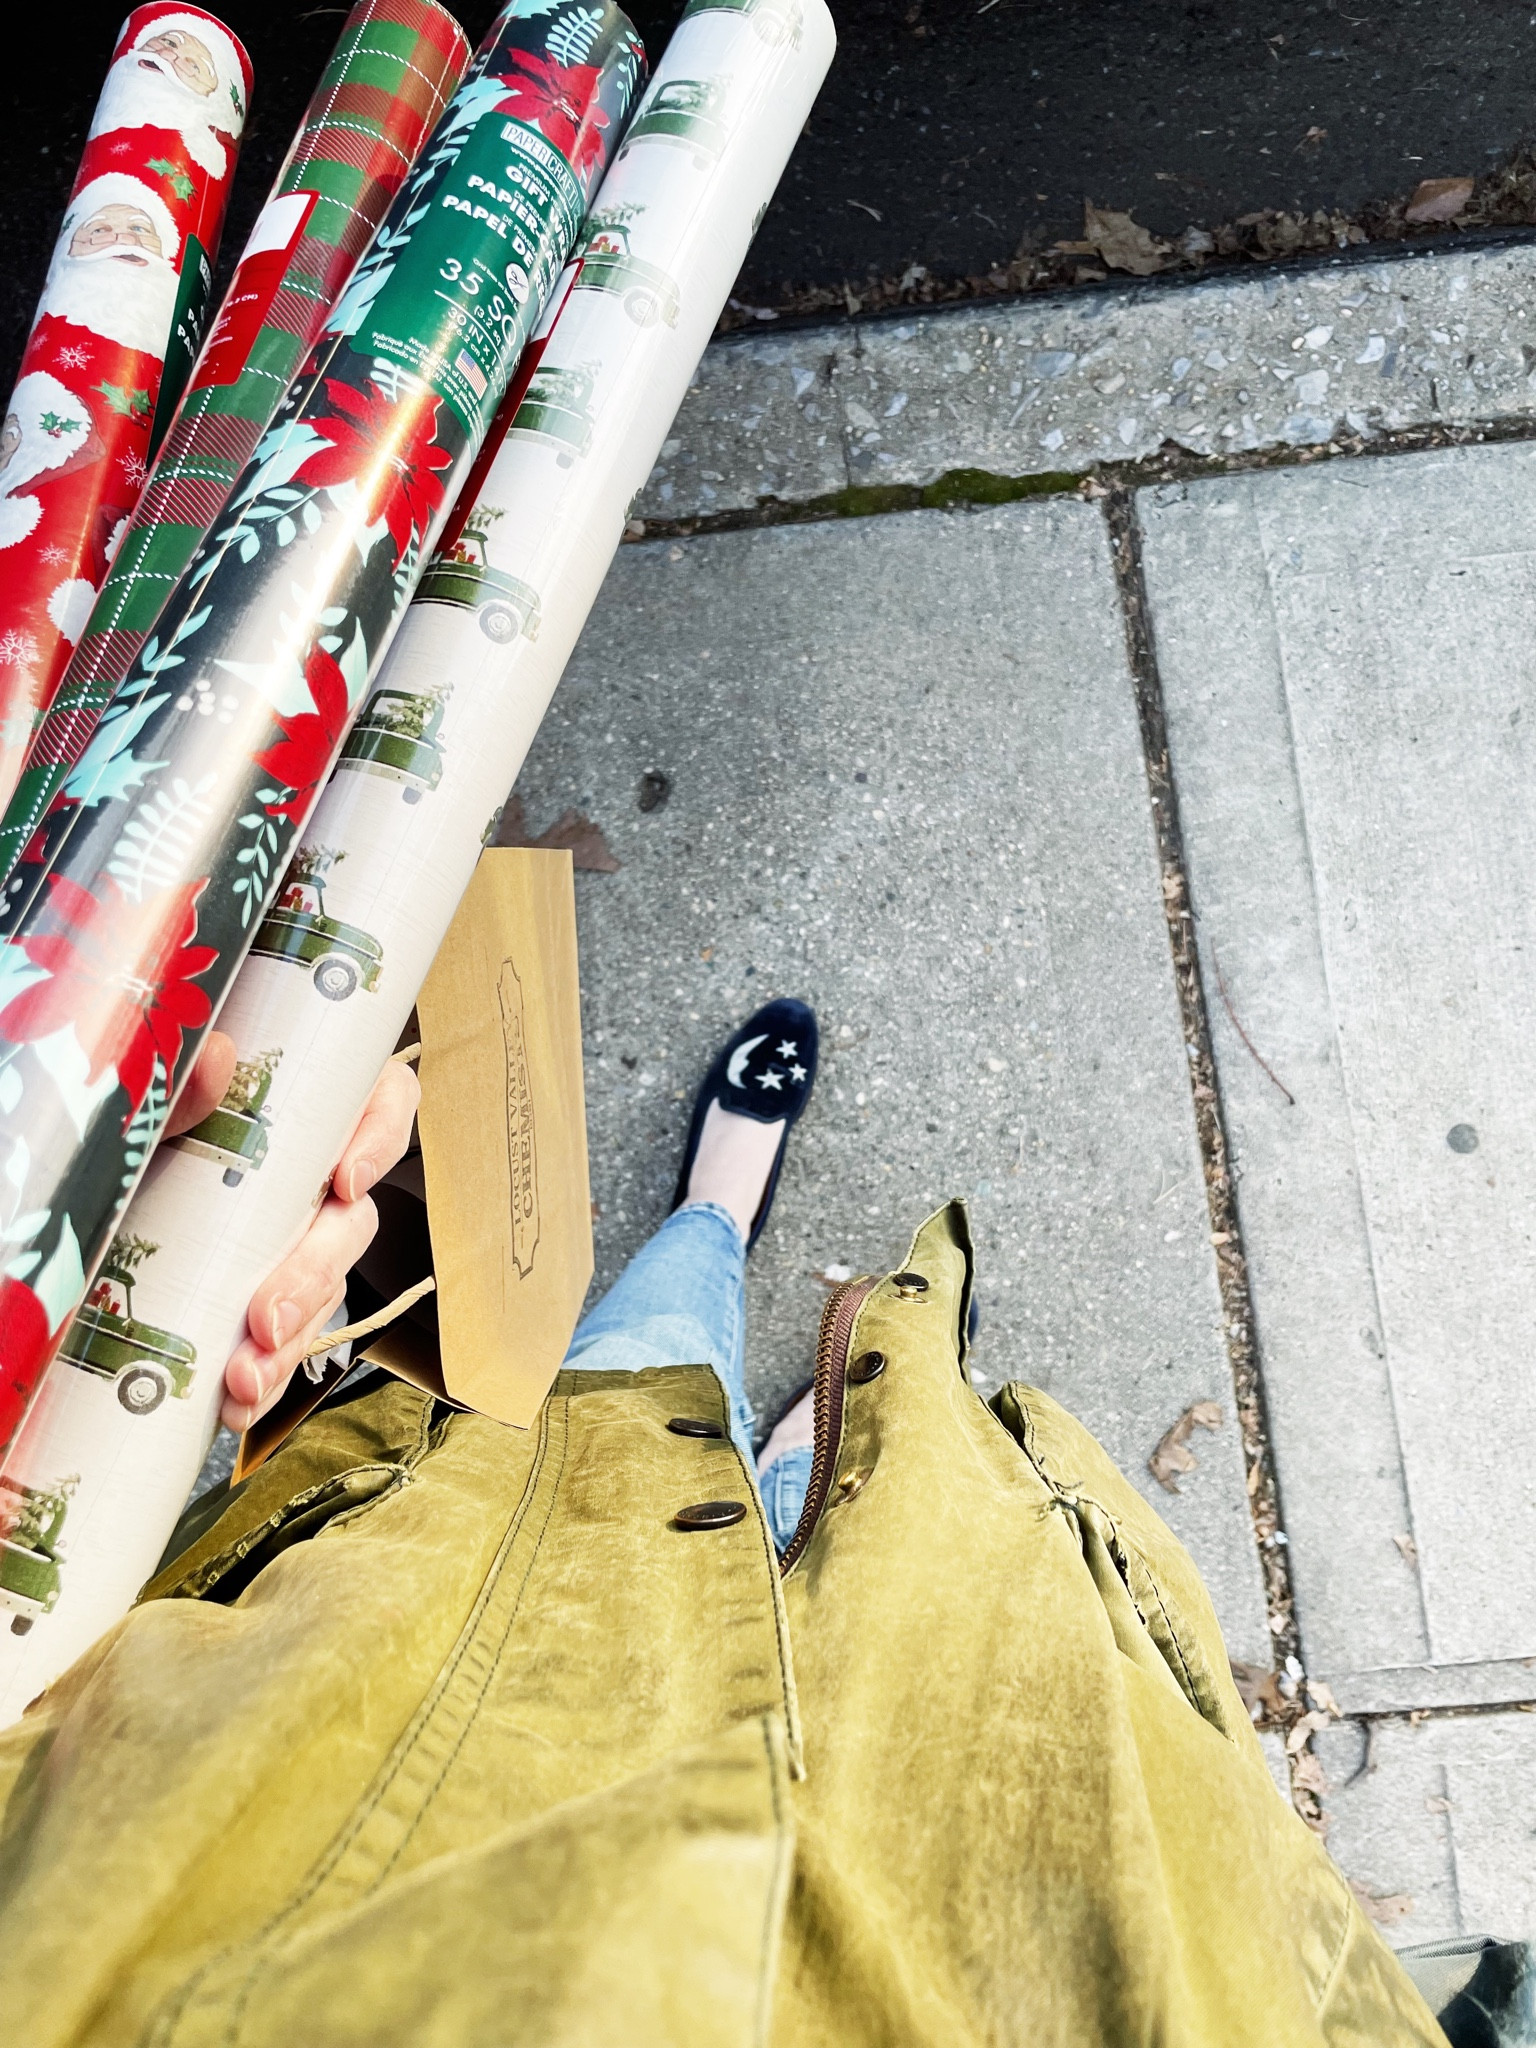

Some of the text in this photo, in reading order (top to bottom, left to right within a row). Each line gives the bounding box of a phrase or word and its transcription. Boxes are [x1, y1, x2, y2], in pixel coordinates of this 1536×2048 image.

[506, 165, 549, 207] GIFT
[513, 190, 526, 202] DE
[443, 194, 508, 240] PAPEL
[511, 234, 535, 269] DE
[503, 214, 514, 227] DE
[439, 257, 484, 296] 35
[487, 294, 517, 349] SQ
[473, 304, 494, 330] (3.2
[447, 306, 467, 327] 30
[468, 323, 484, 345] IN
[511, 1127, 522, 1225] LOCUST
